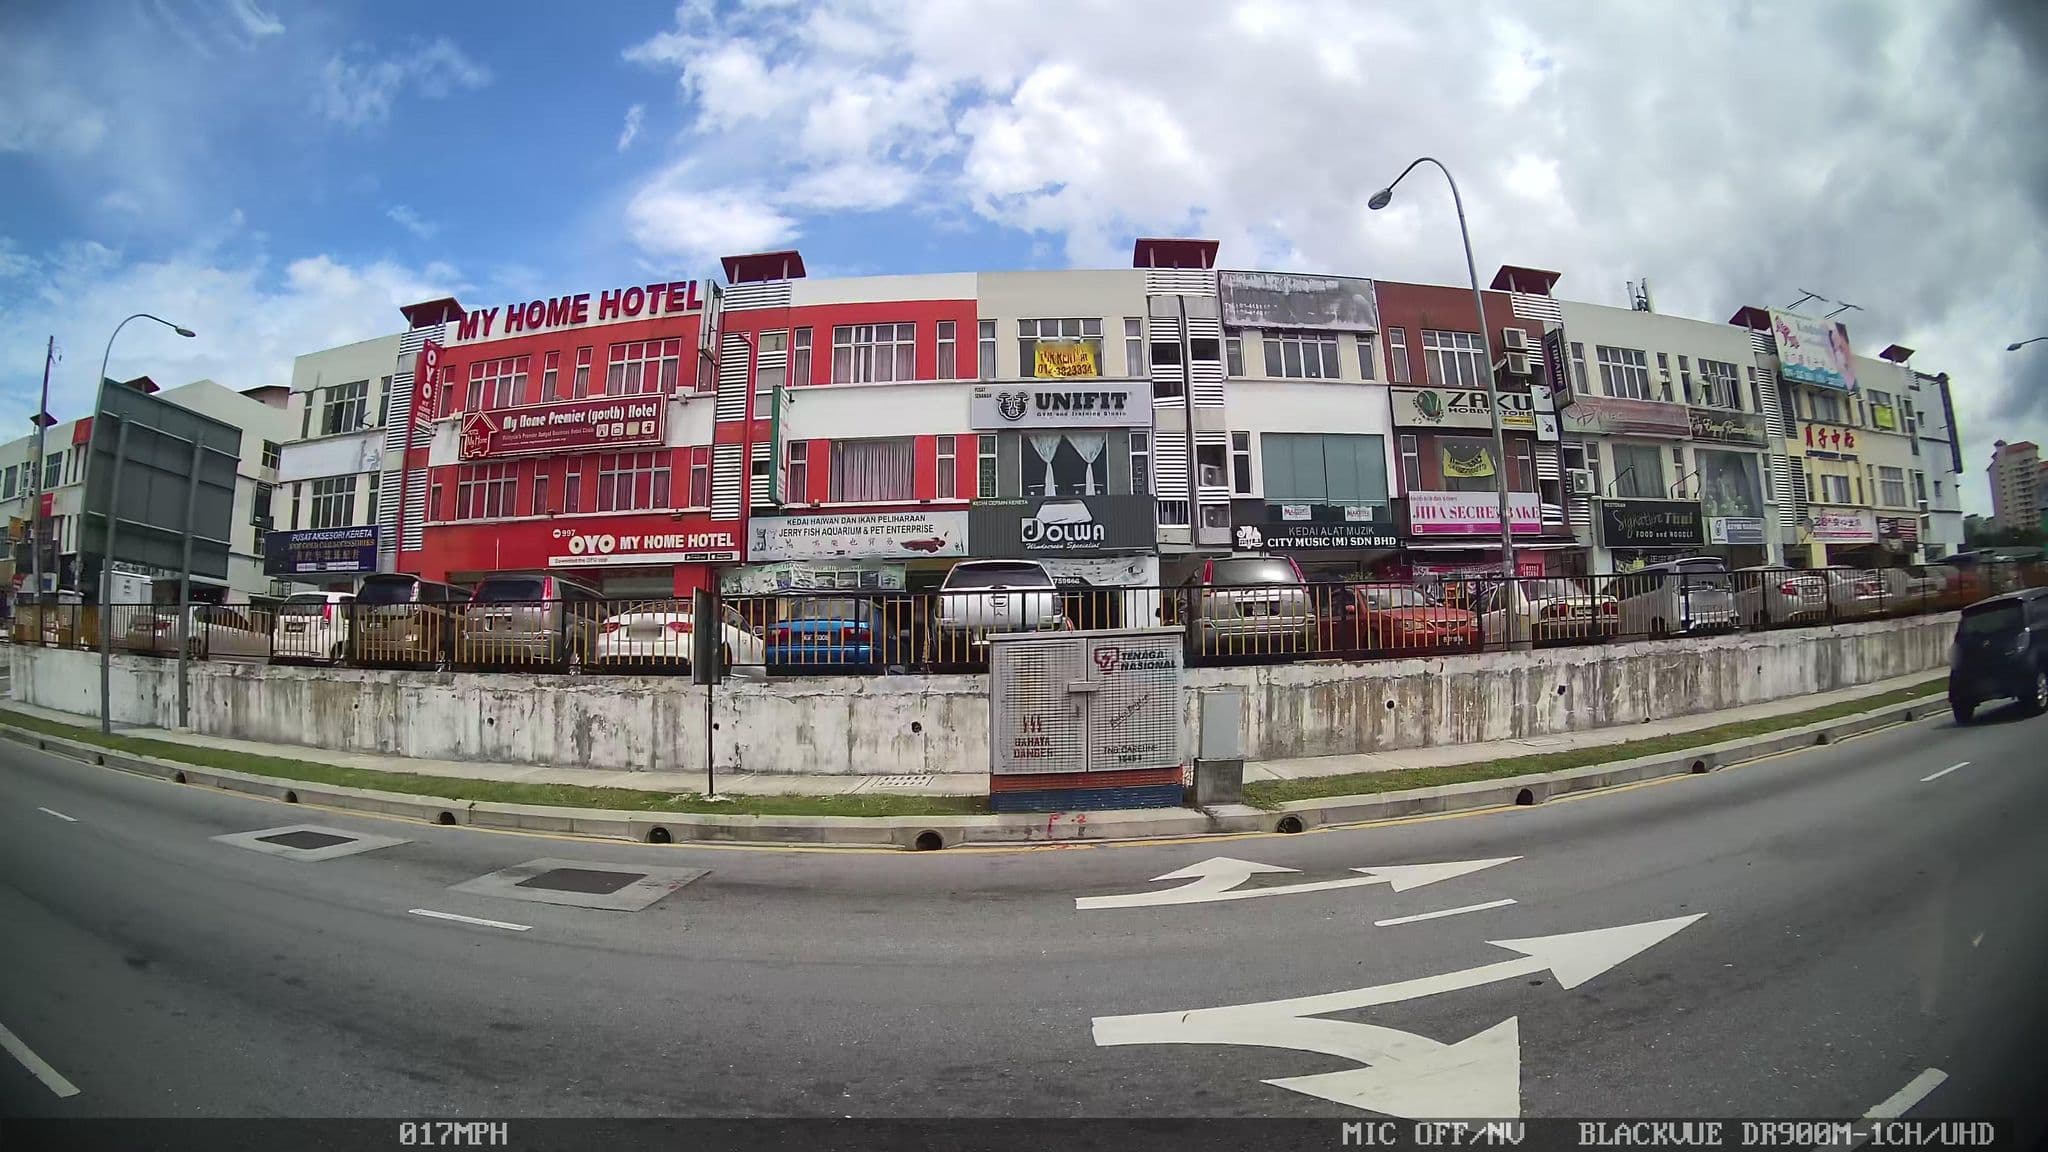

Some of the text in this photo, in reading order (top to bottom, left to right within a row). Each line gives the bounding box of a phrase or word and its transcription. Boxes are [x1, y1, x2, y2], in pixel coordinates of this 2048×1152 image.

[457, 280, 703, 340] MY HOME HOTEL
[422, 350, 437, 399] OYO
[1034, 392, 1128, 410] UNIFIT
[503, 415, 517, 432] My
[548, 410, 585, 425] Premier
[588, 407, 625, 425] (youth)
[628, 403, 657, 419] Hotel
[787, 514, 926, 526] KEDAI HAIWAN DAN IKAN PELIHARAAN
[291, 533, 313, 542] PUSAT
[345, 529, 374, 539] KERETA
[561, 529, 576, 537] 997
[779, 524, 934, 537] JERRY FISH AQUARIUM & PET ENTERPRISE
[1288, 526, 1375, 536] KEDAI ALAT MUZIK
[1635, 530, 1654, 538] FOOD
[568, 532, 736, 555] OYO MY HOME HOTEL
[1267, 537, 1293, 547] CITY
[1295, 537, 1330, 547] MUSIC
[1331, 536, 1348, 547] (M)
[1350, 536, 1372, 546] SDN
[1374, 536, 1397, 546] BHD
[1121, 650, 1165, 660] TENAGA
[1120, 660, 1177, 671] NASIONAL
